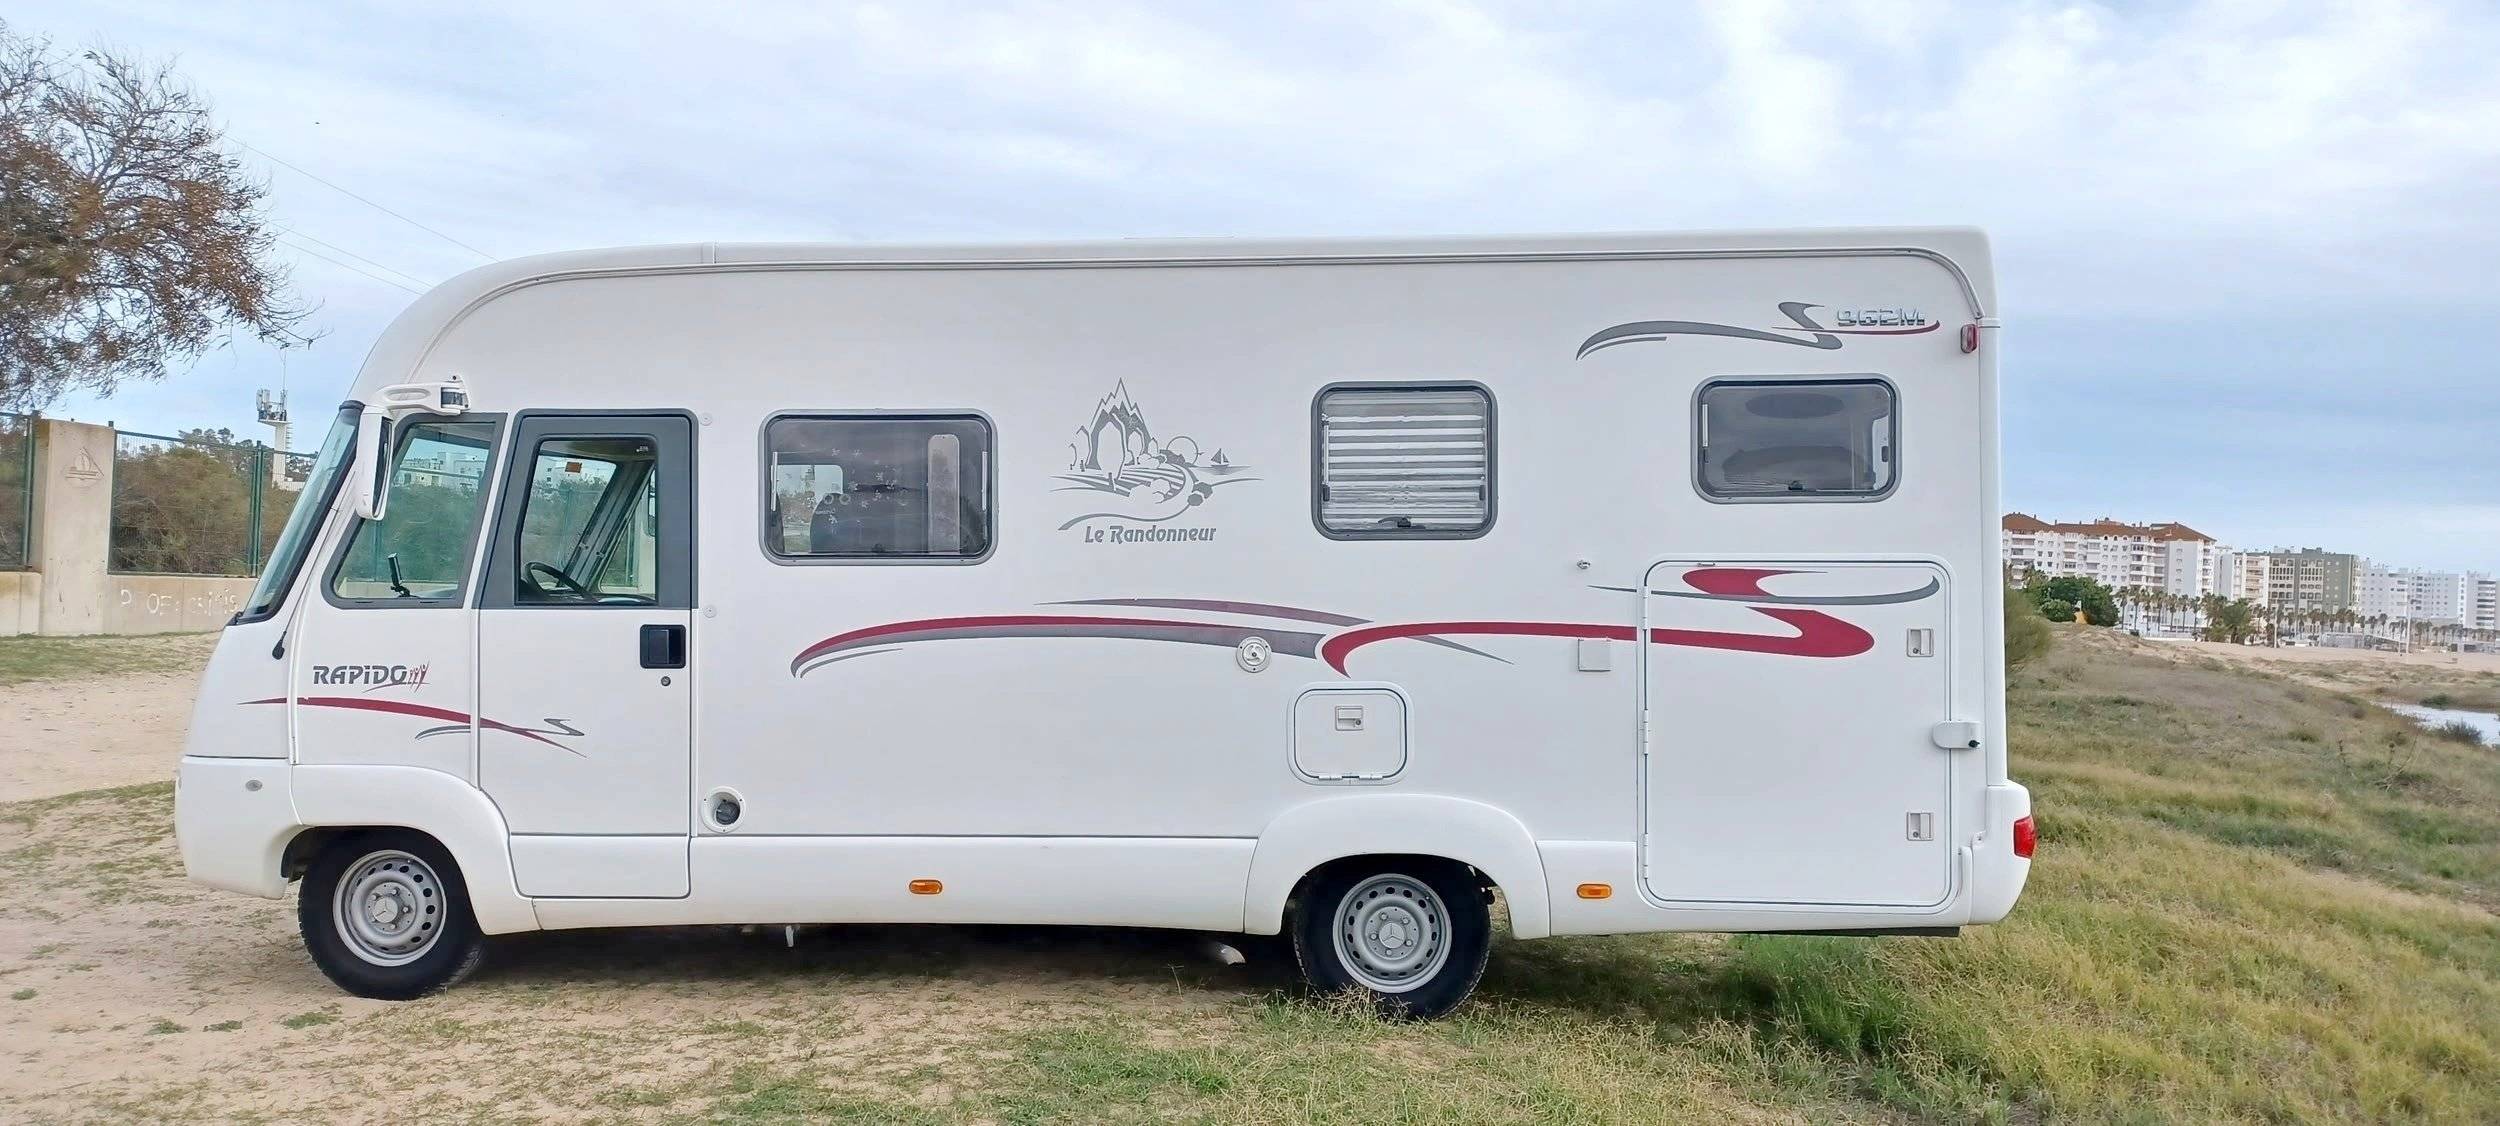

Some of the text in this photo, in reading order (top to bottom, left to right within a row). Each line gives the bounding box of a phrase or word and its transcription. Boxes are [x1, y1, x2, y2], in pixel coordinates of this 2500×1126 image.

[1837, 307, 1925, 326] 962M
[1085, 525, 1216, 544] Le Randonneur
